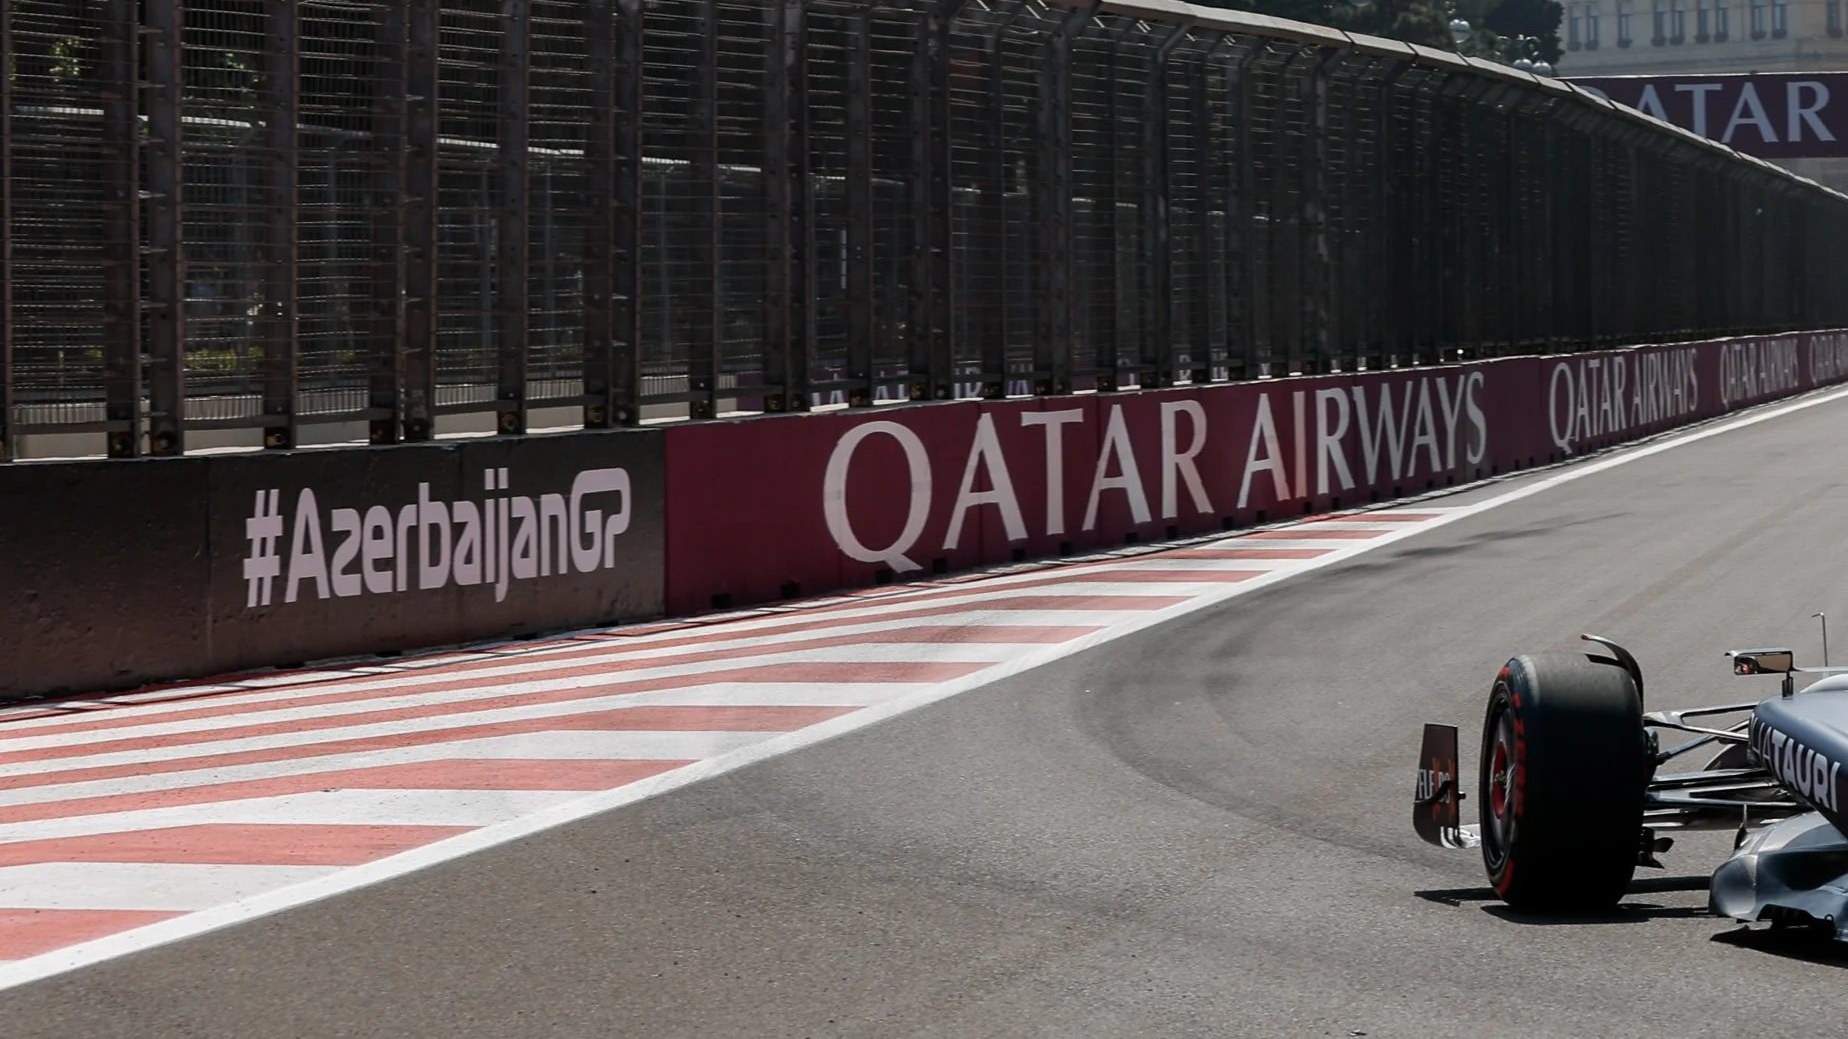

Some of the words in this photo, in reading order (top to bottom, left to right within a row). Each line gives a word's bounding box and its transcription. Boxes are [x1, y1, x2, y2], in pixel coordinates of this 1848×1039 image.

[1579, 80, 1835, 142] ATAR
[1550, 356, 1627, 454] QATAR
[1630, 348, 1698, 427] AIRWAYS
[821, 398, 1214, 572] QATAR
[1239, 372, 1487, 507] AIRWAYS
[243, 467, 631, 609] #AzerbaijanGP
